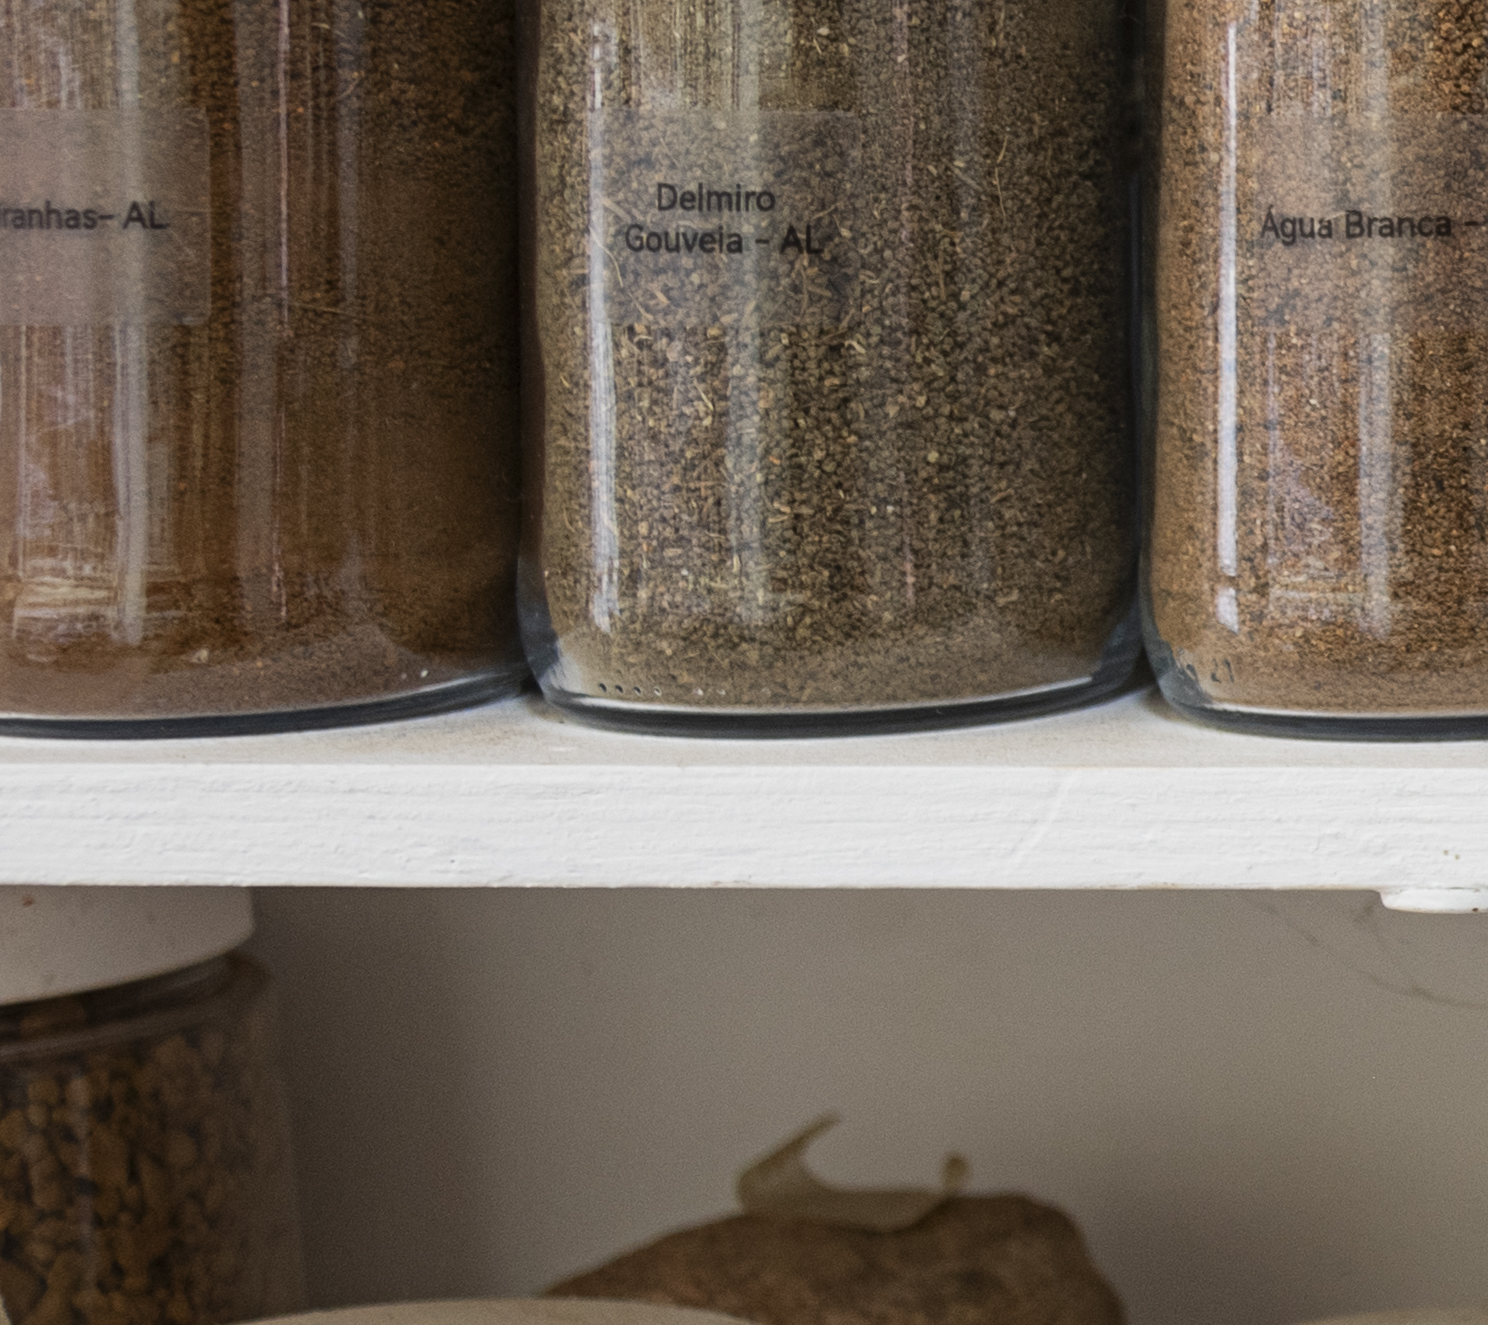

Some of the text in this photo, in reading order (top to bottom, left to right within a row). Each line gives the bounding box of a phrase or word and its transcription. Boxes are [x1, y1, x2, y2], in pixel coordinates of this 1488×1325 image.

[656, 182, 777, 213] Delmiro
[624, 223, 743, 255] Gouveia
[780, 225, 824, 255] AL
[1260, 204, 1333, 246] Água
[1345, 209, 1452, 240] Branca
